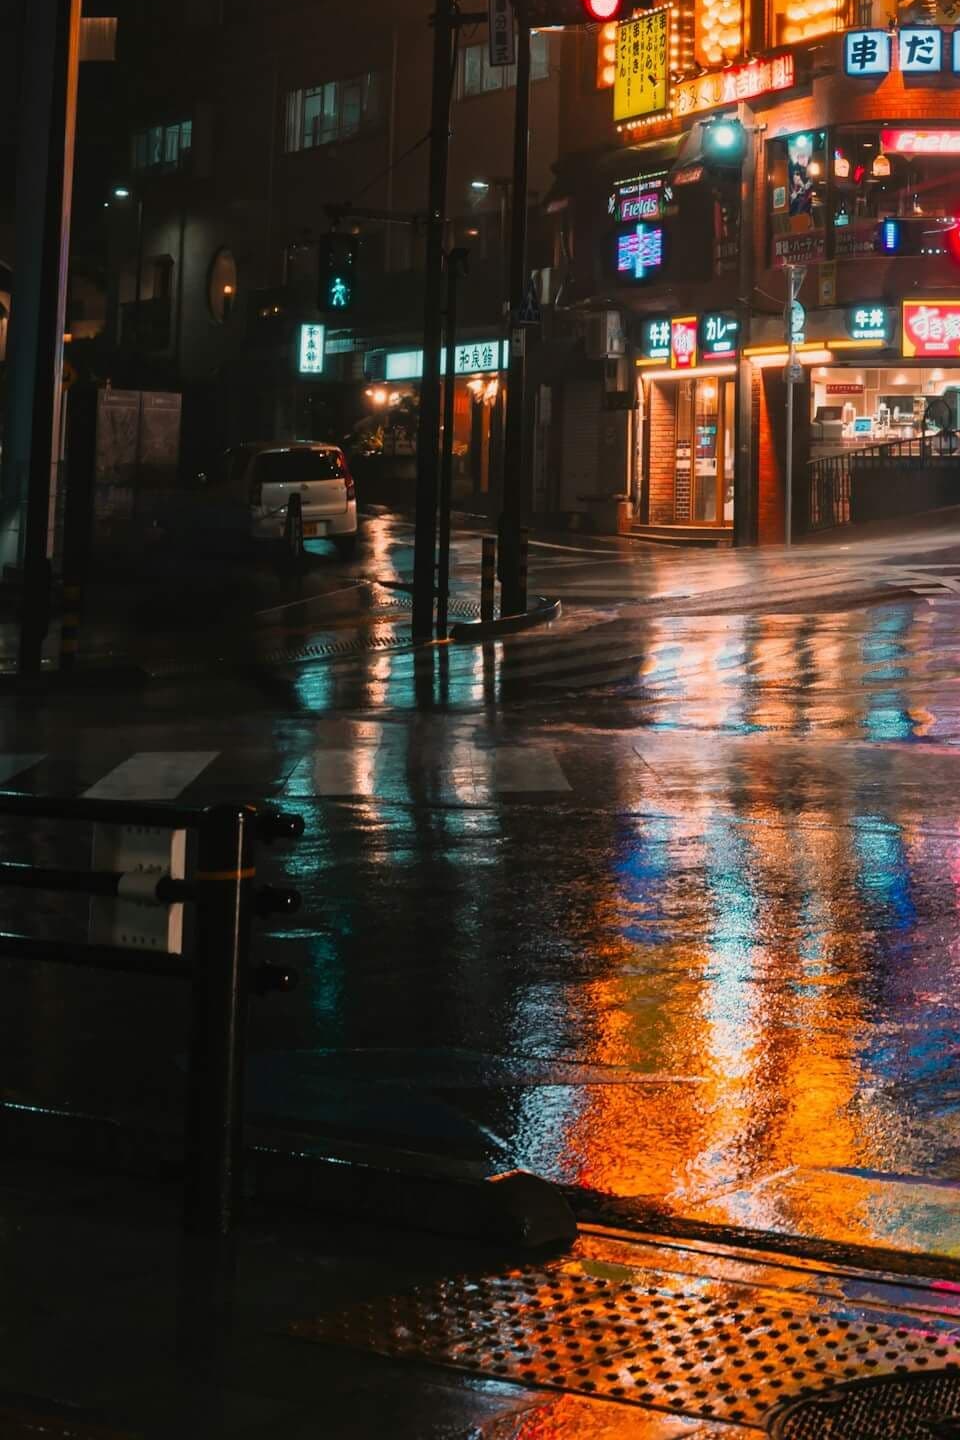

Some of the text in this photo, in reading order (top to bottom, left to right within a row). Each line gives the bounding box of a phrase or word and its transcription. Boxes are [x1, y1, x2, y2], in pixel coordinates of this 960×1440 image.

[622, 198, 658, 218] Fields
[706, 317, 737, 340] カレー
[855, 310, 883, 327] 牛丼
